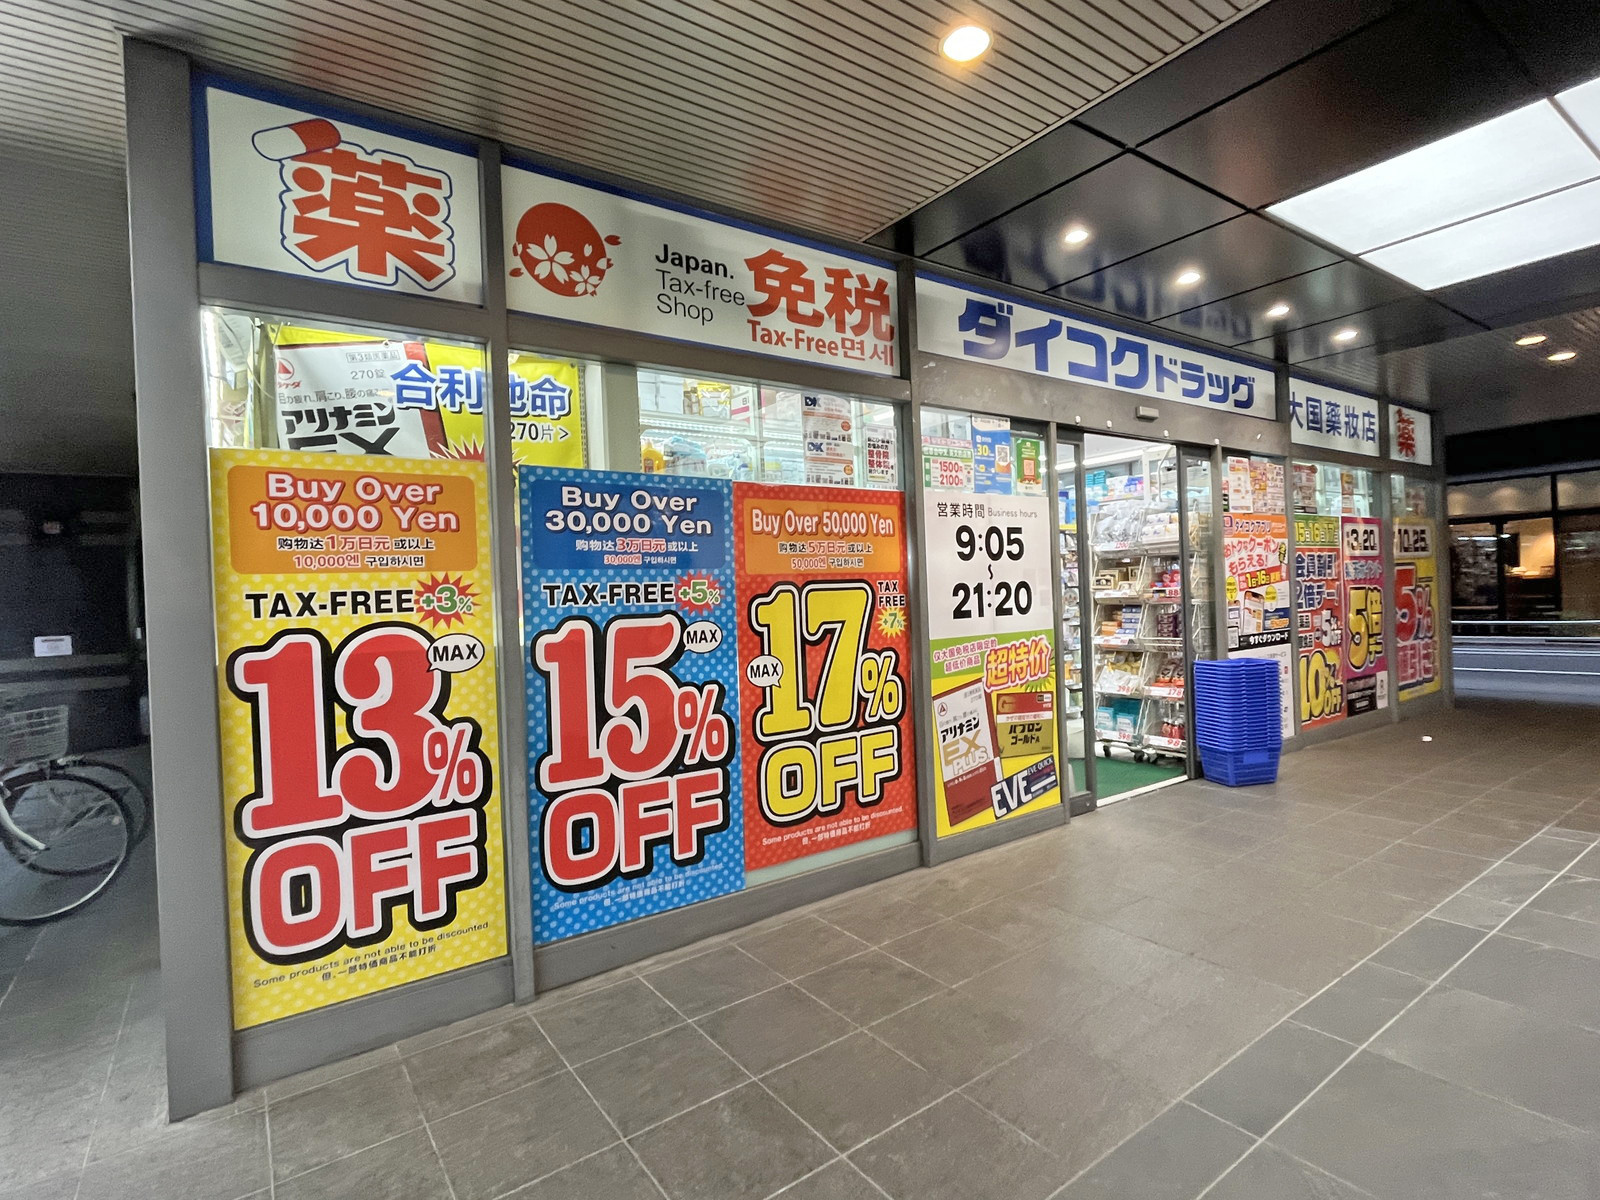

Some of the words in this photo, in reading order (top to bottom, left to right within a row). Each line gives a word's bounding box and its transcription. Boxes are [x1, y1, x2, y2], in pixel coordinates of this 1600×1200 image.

[290, 147, 445, 283] 薬
[655, 244, 735, 279] Japan.
[656, 268, 745, 306] Tax-free
[744, 248, 895, 342] 免税
[657, 293, 714, 326] Shop
[747, 318, 839, 356] Tax-Free
[958, 298, 1255, 409] ダイコクドラッグ
[281, 402, 396, 434] アリナミン
[267, 472, 343, 503] Buy
[355, 476, 441, 503] Over
[561, 486, 620, 511] Buy
[630, 490, 698, 512] Over
[252, 502, 380, 531] 10,000
[392, 506, 458, 531] Yen
[545, 510, 651, 534] 30,000
[661, 514, 712, 534] Yen
[752, 508, 781, 536] Buy
[784, 509, 819, 534] Over
[822, 511, 867, 537] 50,000
[869, 513, 894, 535] Yen
[937, 501, 985, 519] 営業時間
[987, 507, 1018, 518] Business
[1019, 509, 1039, 518] hours
[955, 524, 1025, 562] 9:05
[293, 553, 360, 569] 10,000엔
[365, 555, 425, 568] 구입하시면
[542, 583, 676, 606] TAX-FREE
[877, 580, 899, 593] TAX
[878, 594, 906, 608] FREE
[951, 580, 1033, 620] 21:20
[245, 588, 415, 619] TAX-FREE
[432, 643, 479, 663] MAX
[686, 628, 719, 645] MAX
[749, 662, 780, 679] MAX
[985, 638, 1051, 689] 超特价
[942, 728, 981, 767] EX
[763, 729, 897, 819] OFF
[991, 769, 1033, 818] EVE
[546, 766, 725, 884] OFF
[762, 836, 782, 847] Some
[783, 829, 814, 842] products
[814, 825, 826, 834] are
[826, 822, 839, 831] not
[853, 816, 861, 824] to
[255, 811, 475, 951] OFF
[553, 899, 578, 911] Some
[578, 891, 616, 906] products
[617, 886, 631, 894] are
[632, 881, 645, 891] not
[665, 875, 673, 883] to
[674, 873, 684, 881] be
[253, 974, 286, 989] Some
[289, 961, 340, 981] products
[343, 954, 360, 966] are
[363, 949, 381, 961] not
[384, 942, 406, 955] able
[409, 940, 420, 949] to
[421, 936, 434, 946] be
[436, 921, 490, 942] discounted
